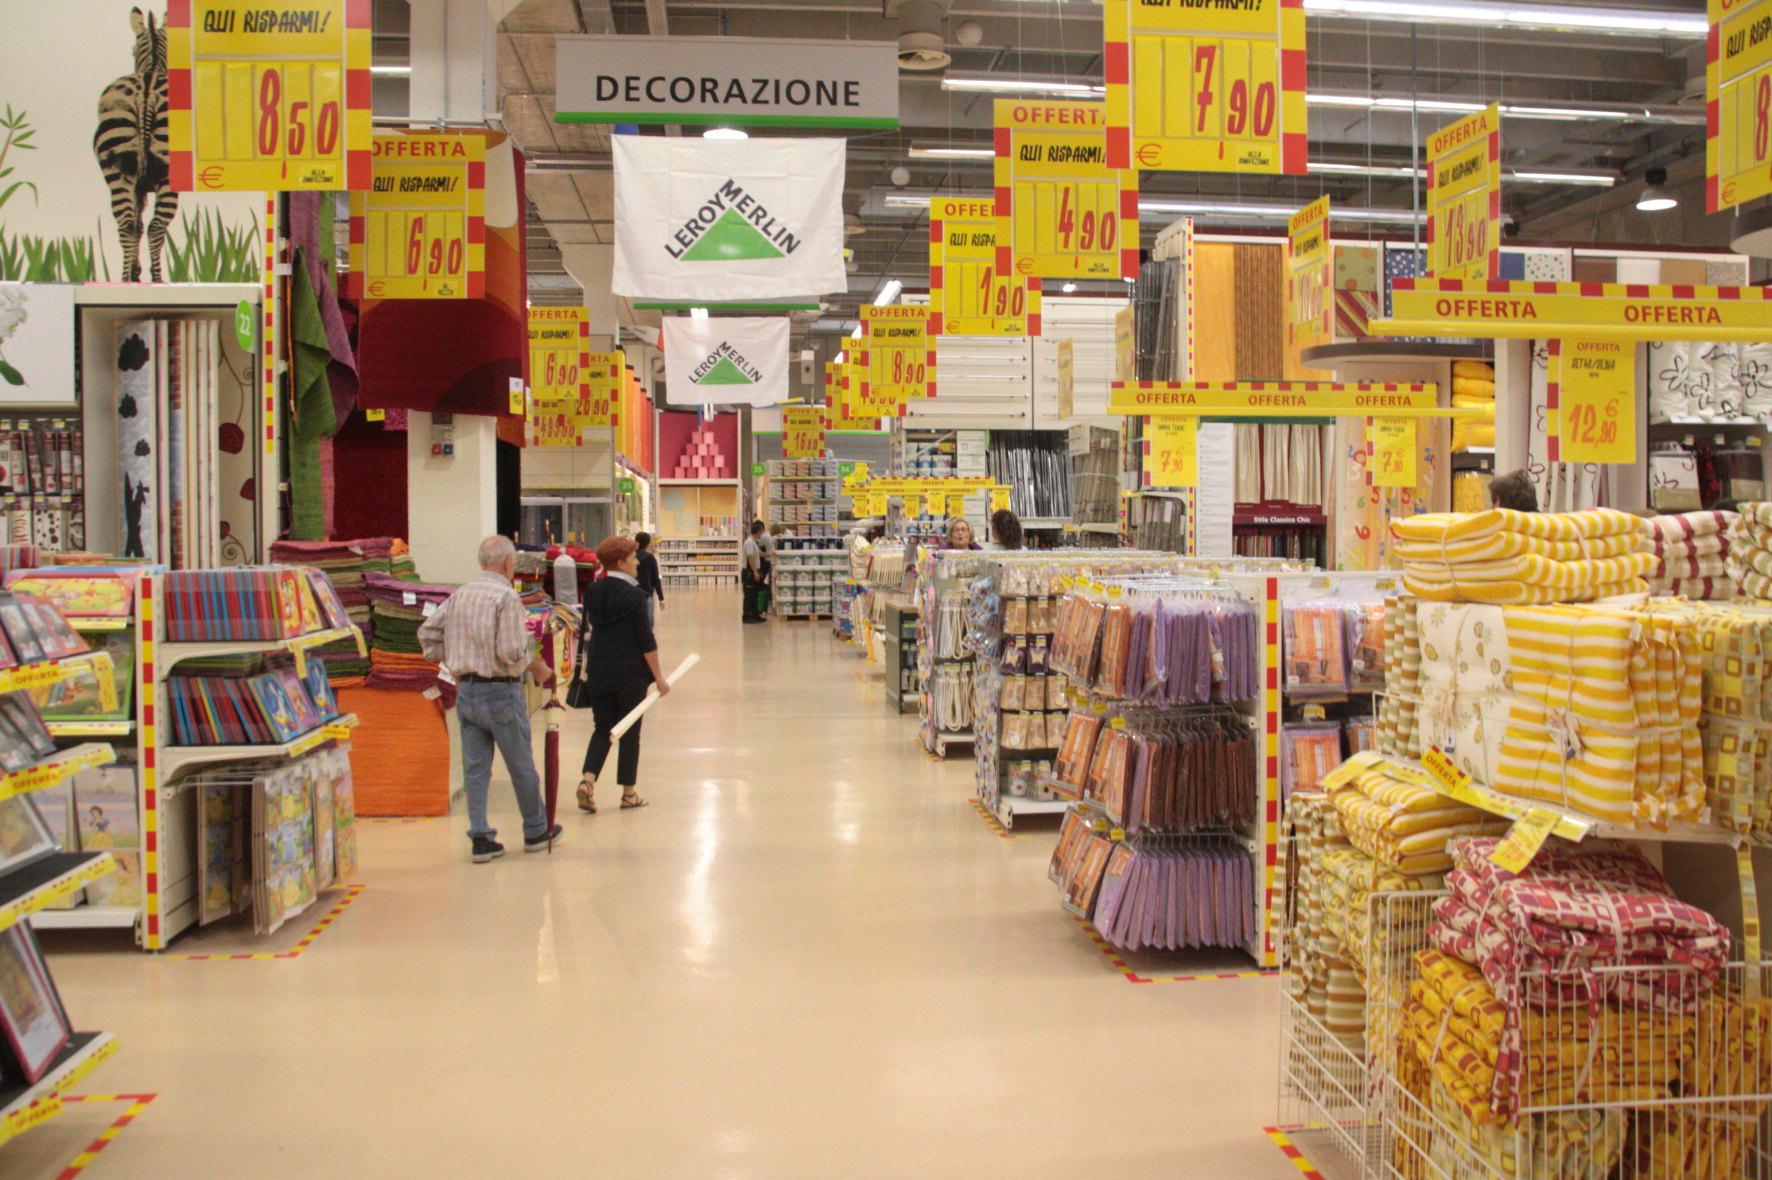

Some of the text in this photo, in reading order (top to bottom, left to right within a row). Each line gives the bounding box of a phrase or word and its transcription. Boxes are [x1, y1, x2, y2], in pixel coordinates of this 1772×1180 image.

[204, 10, 332, 33] QUI RISPARMI!
[595, 75, 860, 107] DECORAZIONE
[1013, 106, 1106, 125] OFFERT
[1434, 116, 1488, 153] OFFERTA
[1019, 145, 1042, 161] QUI
[373, 177, 458, 192] QUI RISPARMI!
[1438, 169, 1450, 188] QUI
[664, 178, 802, 260] LEROY MERLIN
[1293, 205, 1324, 230] OFFERTA
[950, 232, 967, 246] QUI
[528, 310, 579, 319] FFERTA
[869, 308, 926, 317] OFFERTA
[1436, 298, 1537, 319] OFFERTA
[1624, 304, 1722, 324] OFFERTA
[239, 316, 251, 336] 22
[1577, 342, 1621, 352] OFFERTA
[688, 341, 763, 384] LEROY MERLIN
[1136, 393, 1196, 405] OFFERTA
[1248, 395, 1306, 406] OFFERTA
[1355, 395, 1412, 406] OFFERTA
[1253, 516, 1311, 524] Stile Classico Chic
[15, 670, 59, 684] OFFERTA
[1425, 754, 1457, 788] OFFERTA
[14, 773, 58, 788] OFFERTA
